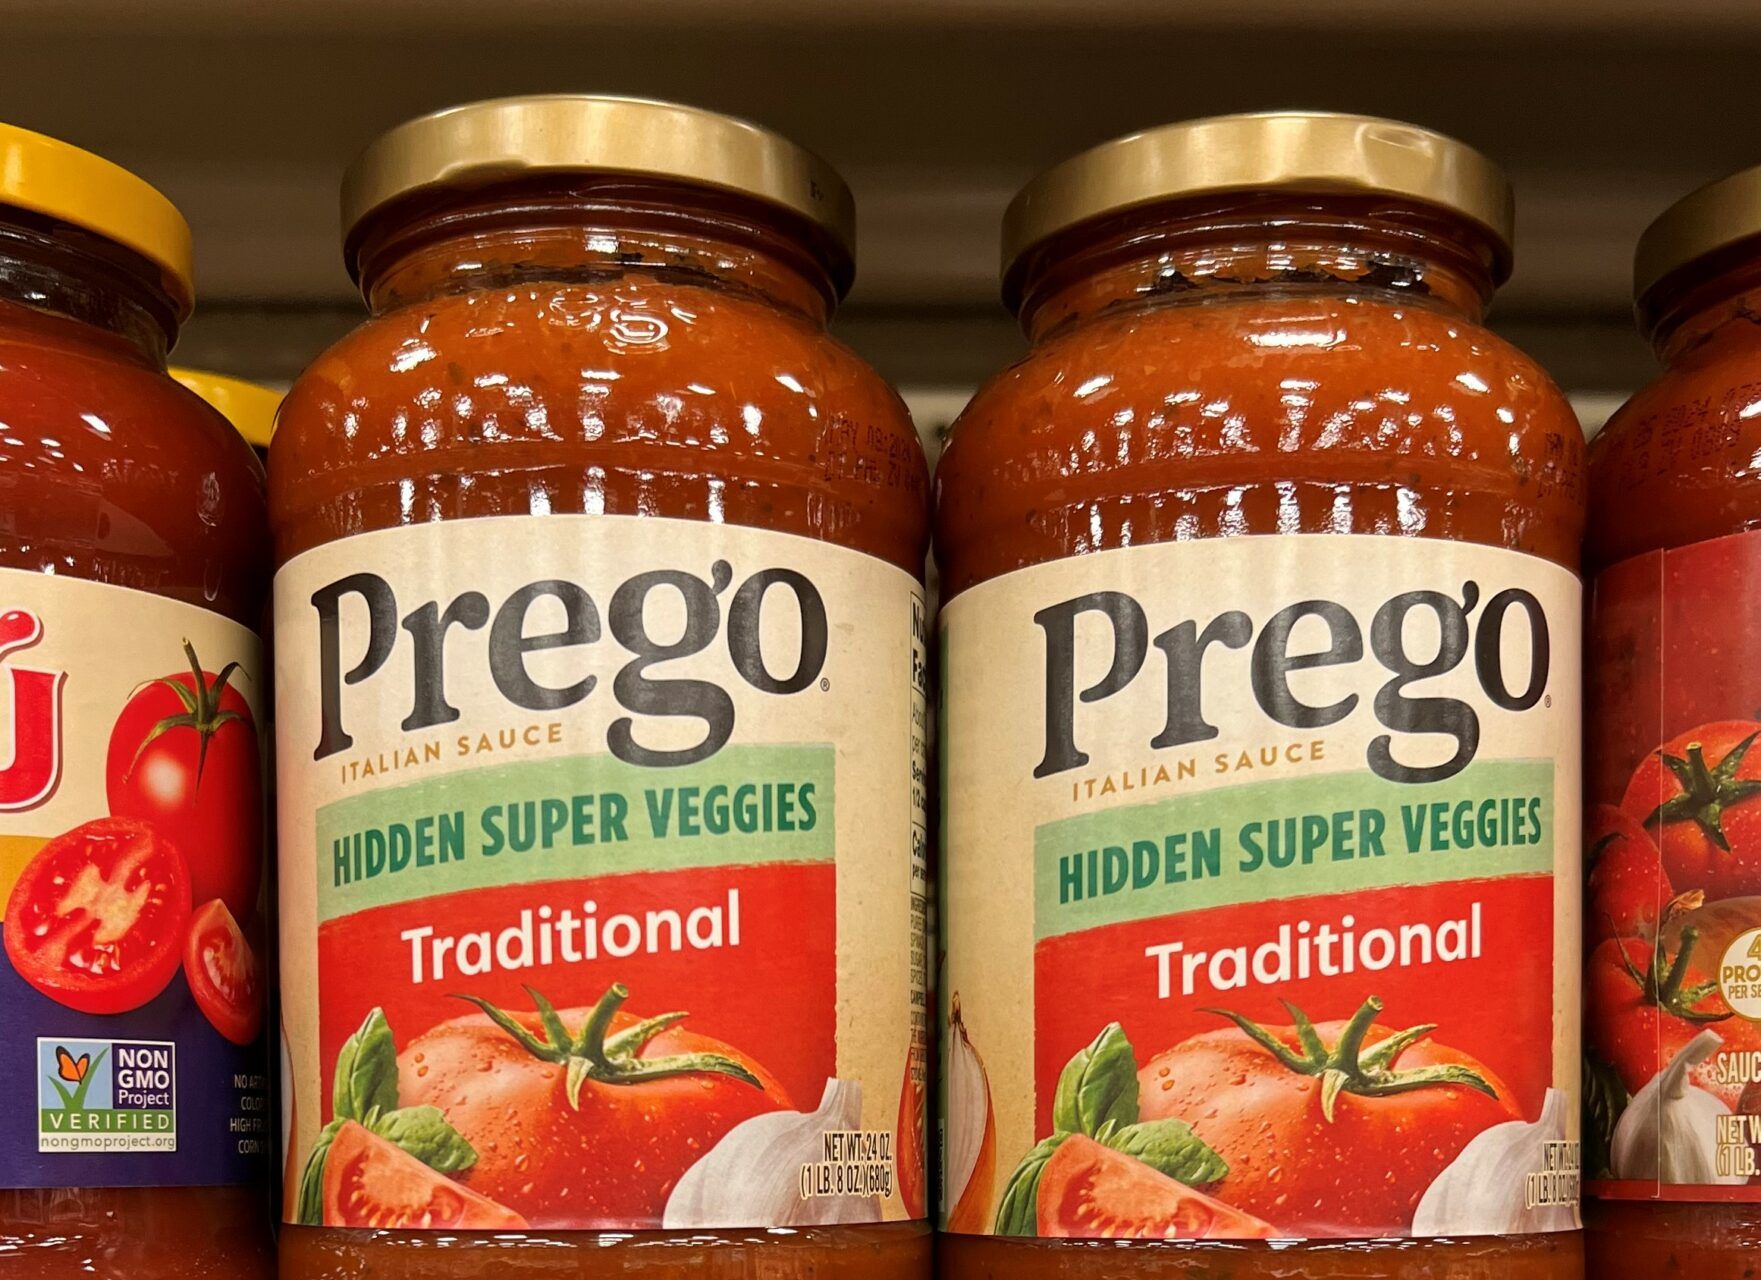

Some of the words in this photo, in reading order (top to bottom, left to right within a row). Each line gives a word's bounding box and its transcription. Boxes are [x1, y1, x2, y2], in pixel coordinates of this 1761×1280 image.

[311, 559, 828, 768] Prego
[1033, 580, 1551, 784] Prego
[340, 741, 441, 785] ITALIAN
[458, 722, 563, 758] SAUCE
[1073, 757, 1195, 802] ITALIAN
[1214, 739, 1326, 775] SAUCE
[333, 811, 466, 887] HIDDEN
[481, 792, 629, 857] SUPER
[644, 782, 817, 839] VEGGIES
[1059, 827, 1222, 905] HIDDEN
[1239, 808, 1387, 873] SUPER
[1400, 797, 1542, 853] VEGGIES
[401, 888, 740, 984] Traditional
[1145, 902, 1483, 1000] Traditional
[1728, 985, 1747, 1000] PER
[118, 1049, 168, 1068] NON
[118, 1069, 170, 1089] GMO
[119, 1090, 169, 1109] Project
[50, 1113, 169, 1130] VERIFIED
[230, 1117, 251, 1132] HIGH
[1716, 1115, 1746, 1144] NET
[41, 1136, 175, 1150] nongmoproject.org
[824, 1133, 844, 1162] NET
[846, 1133, 864, 1162] WT.
[866, 1133, 878, 1160] 24
[879, 1132, 893, 1160] OZ.
[1716, 1145, 1731, 1177] (1
[1736, 1146, 1760, 1176] LB.
[801, 1165, 813, 1199] (1
[817, 1165, 834, 1195] LB.
